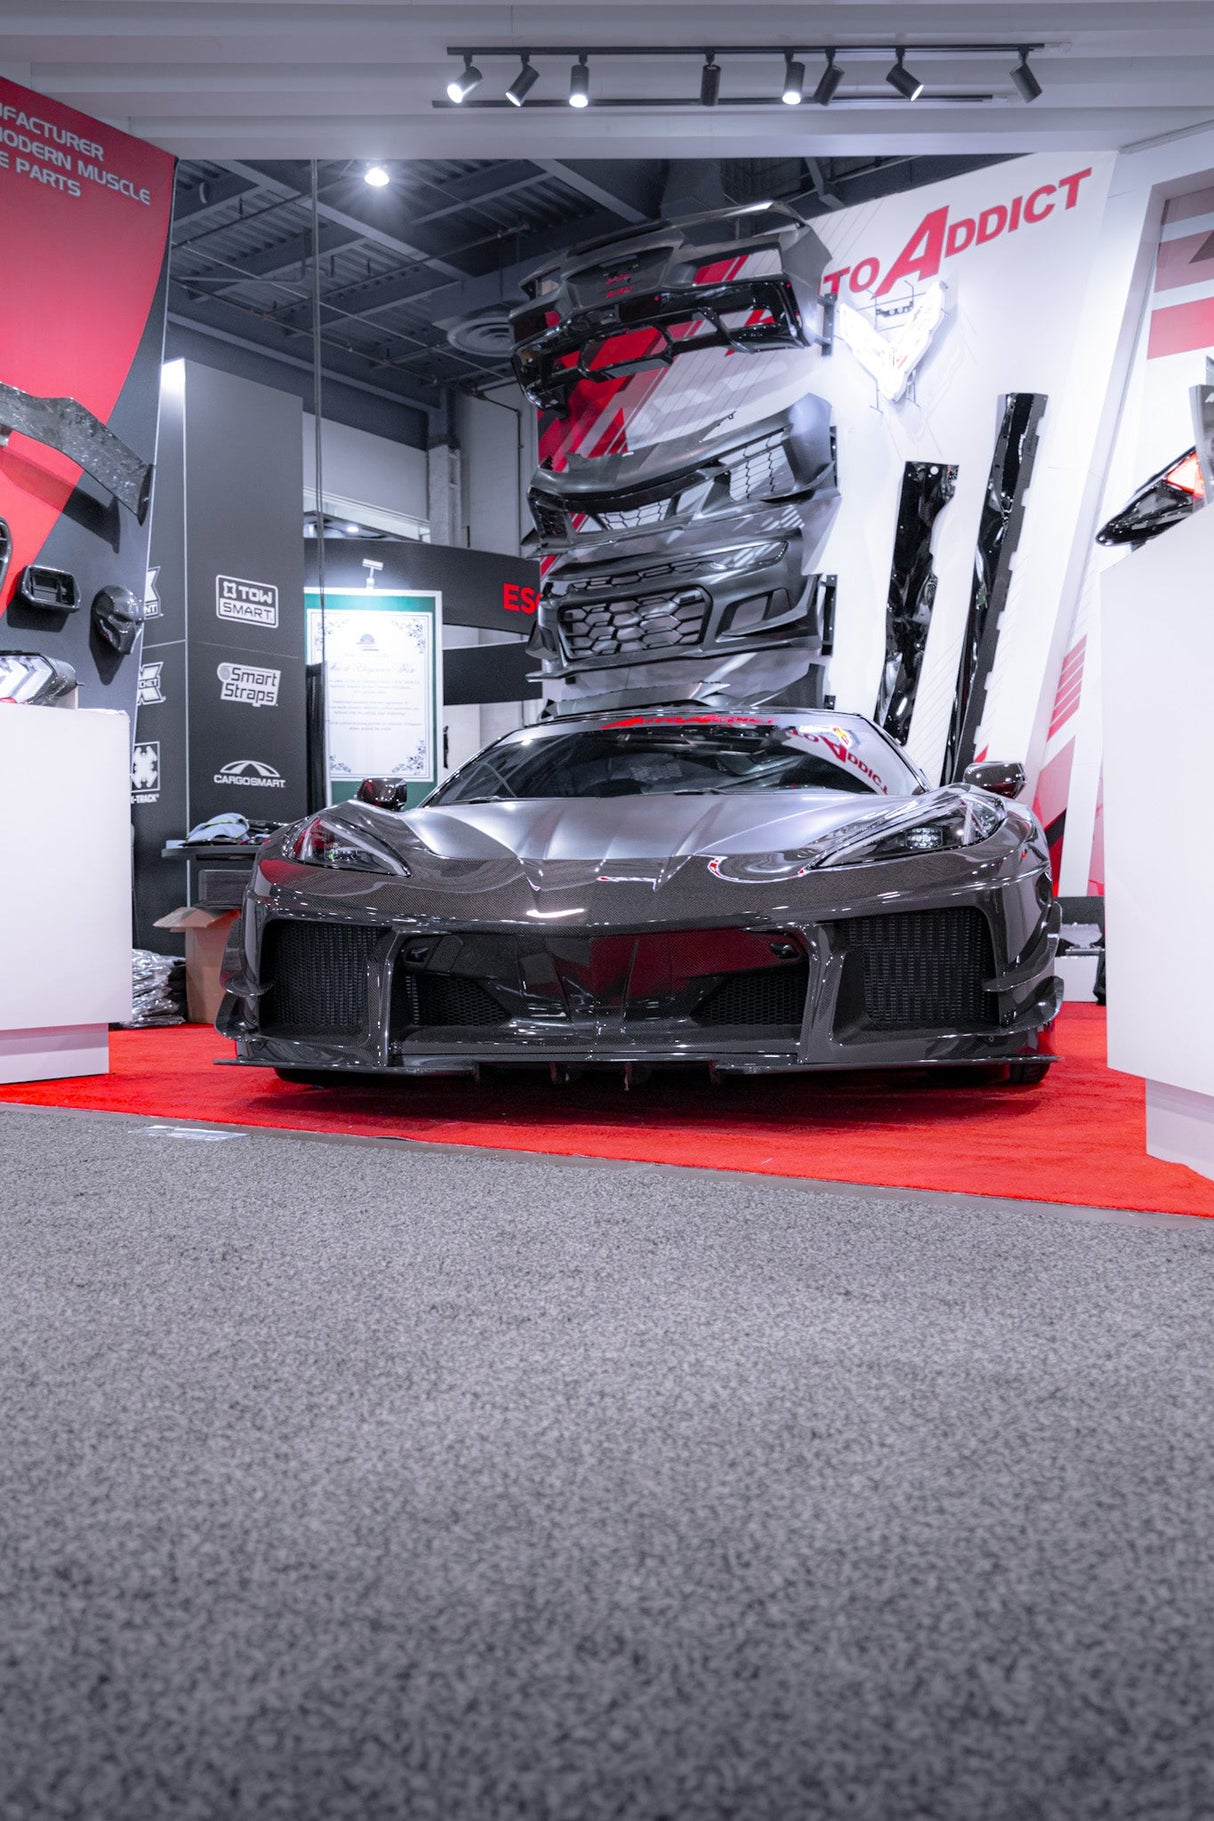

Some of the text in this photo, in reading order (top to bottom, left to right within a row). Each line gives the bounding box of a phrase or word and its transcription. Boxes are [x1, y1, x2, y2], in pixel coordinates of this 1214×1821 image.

[0, 102, 104, 162] FACTURER
[0, 127, 151, 206] ODERN MUSCLE
[15, 157, 81, 197] PARTS
[238, 586, 272, 604] TOW
[223, 602, 273, 621] SMART
[231, 667, 277, 687] Smart
[224, 683, 275, 704] Straps
[213, 774, 286, 788] CARGOSMART
